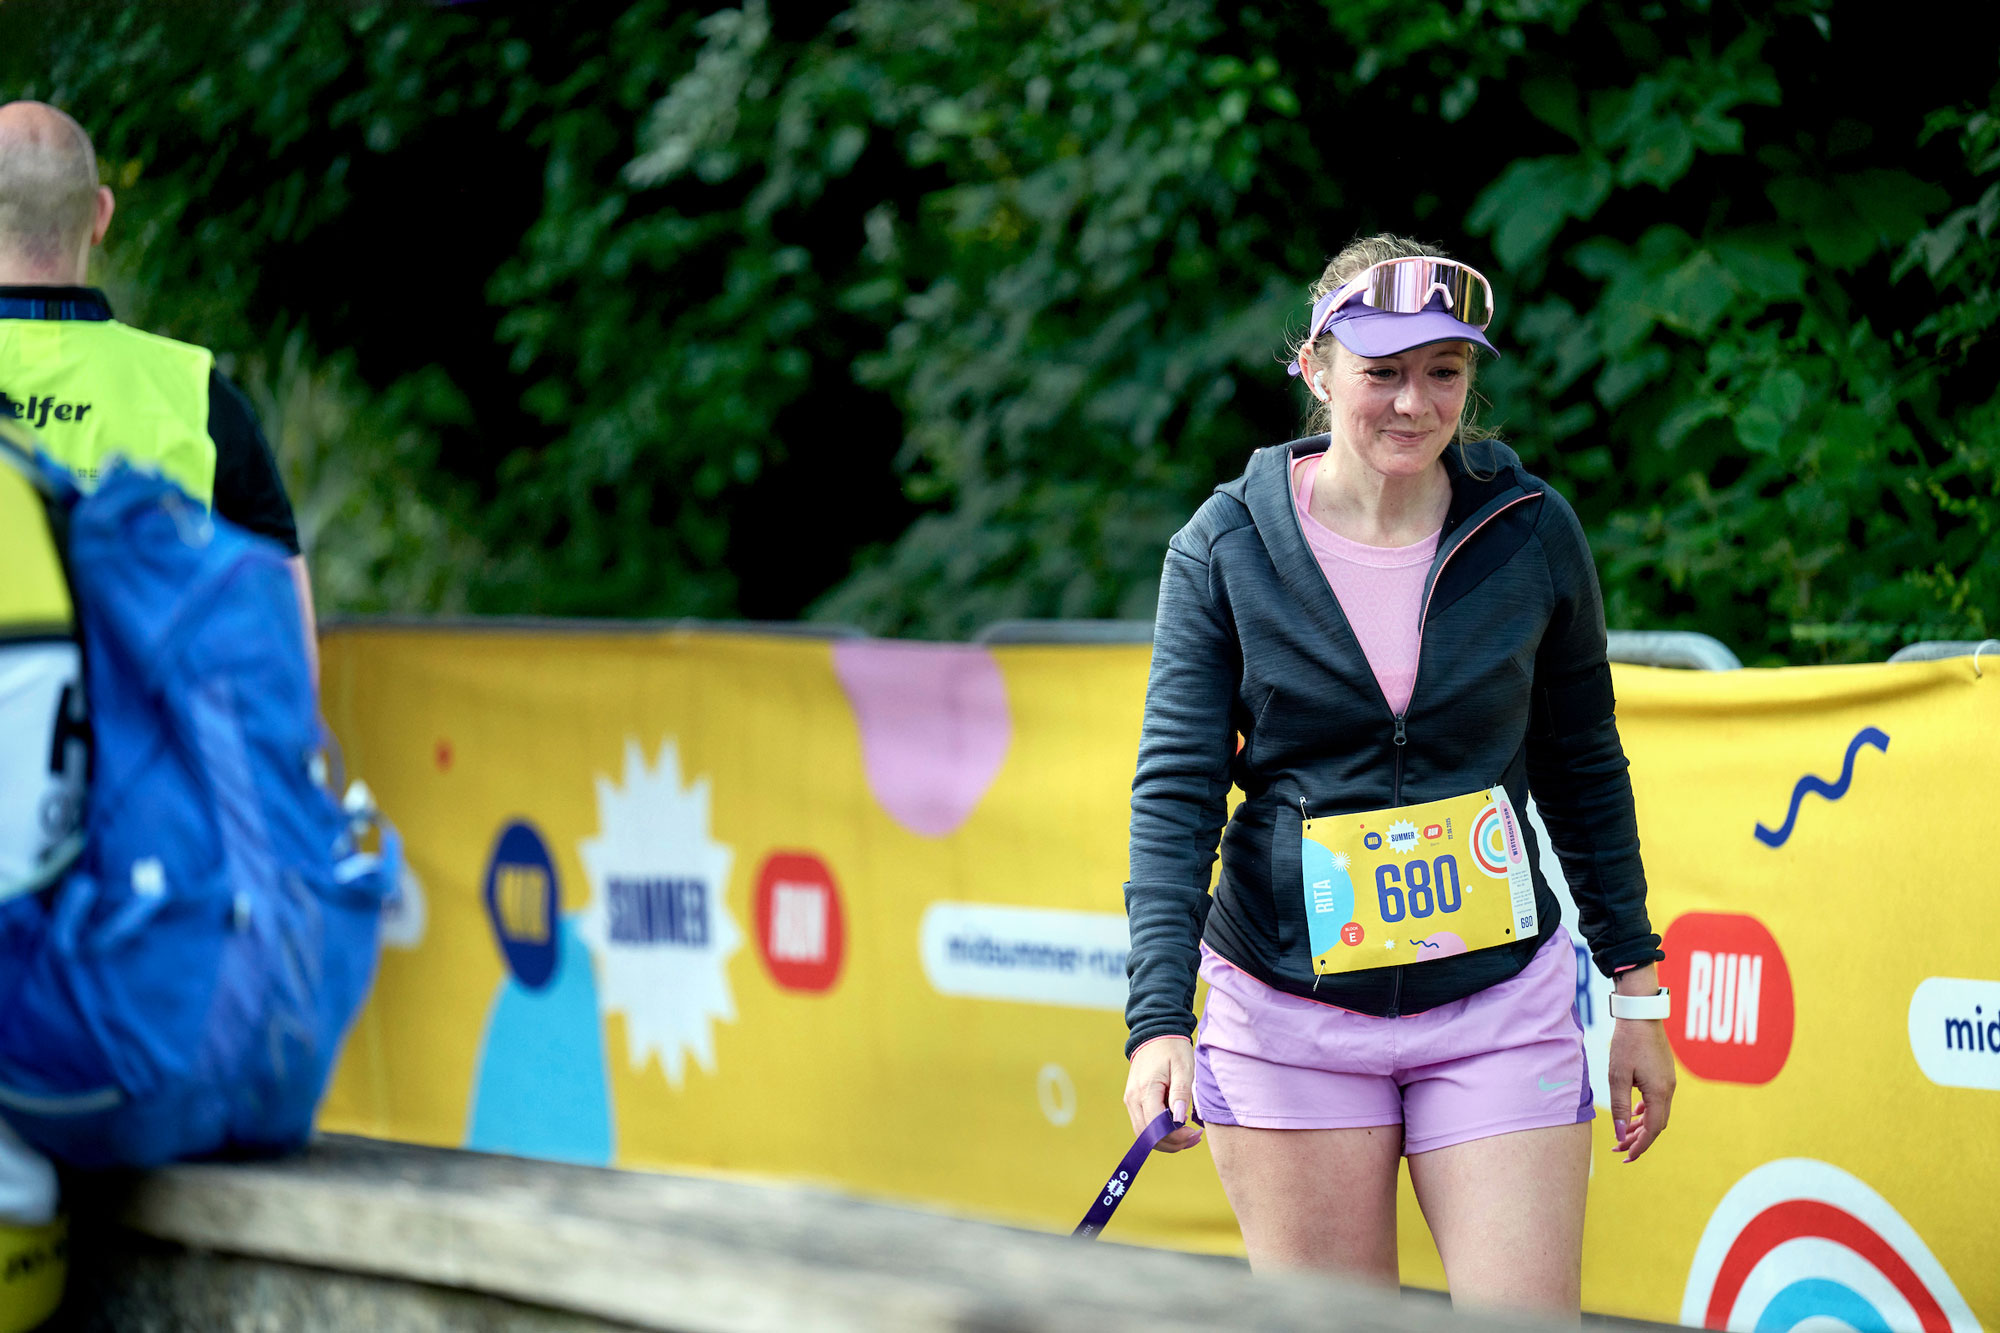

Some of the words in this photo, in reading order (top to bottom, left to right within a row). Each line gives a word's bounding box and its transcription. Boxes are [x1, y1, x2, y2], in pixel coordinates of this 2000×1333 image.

[0, 393, 91, 428] elfer
[1391, 831, 1416, 842] SUMMER
[1312, 879, 1335, 914] RITA
[1375, 854, 1462, 923] 680
[1349, 932, 1357, 943] E
[1520, 915, 1534, 929] 680
[1685, 950, 1763, 1045] RUN
